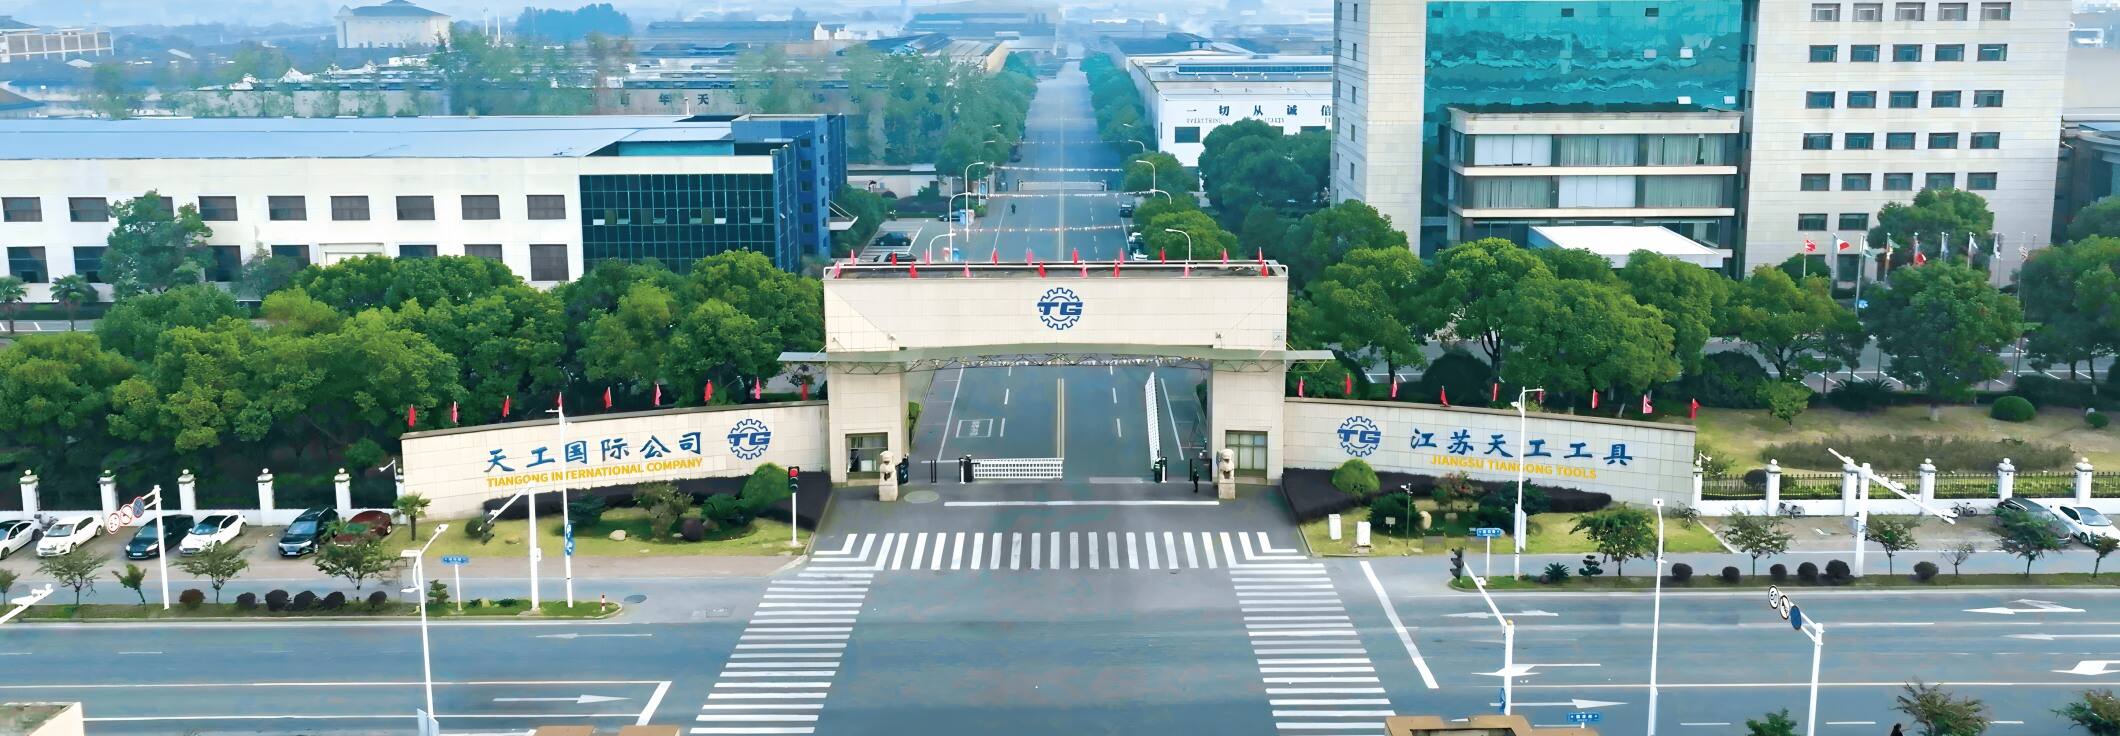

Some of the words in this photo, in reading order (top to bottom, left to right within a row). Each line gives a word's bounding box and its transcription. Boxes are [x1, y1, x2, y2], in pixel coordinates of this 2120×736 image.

[1037, 302, 1083, 316] TG
[727, 432, 771, 446] TG
[1337, 429, 1381, 444] TG
[1410, 428, 1633, 466] 江苏天工工具
[484, 432, 701, 472] 天工国际公司
[487, 473, 548, 487] TIANGONG
[551, 463, 643, 481] INTERNATIONAL
[647, 458, 702, 472] COMPANY
[1432, 455, 1484, 469] JIANGSU
[1556, 465, 1597, 479] TOOLS
